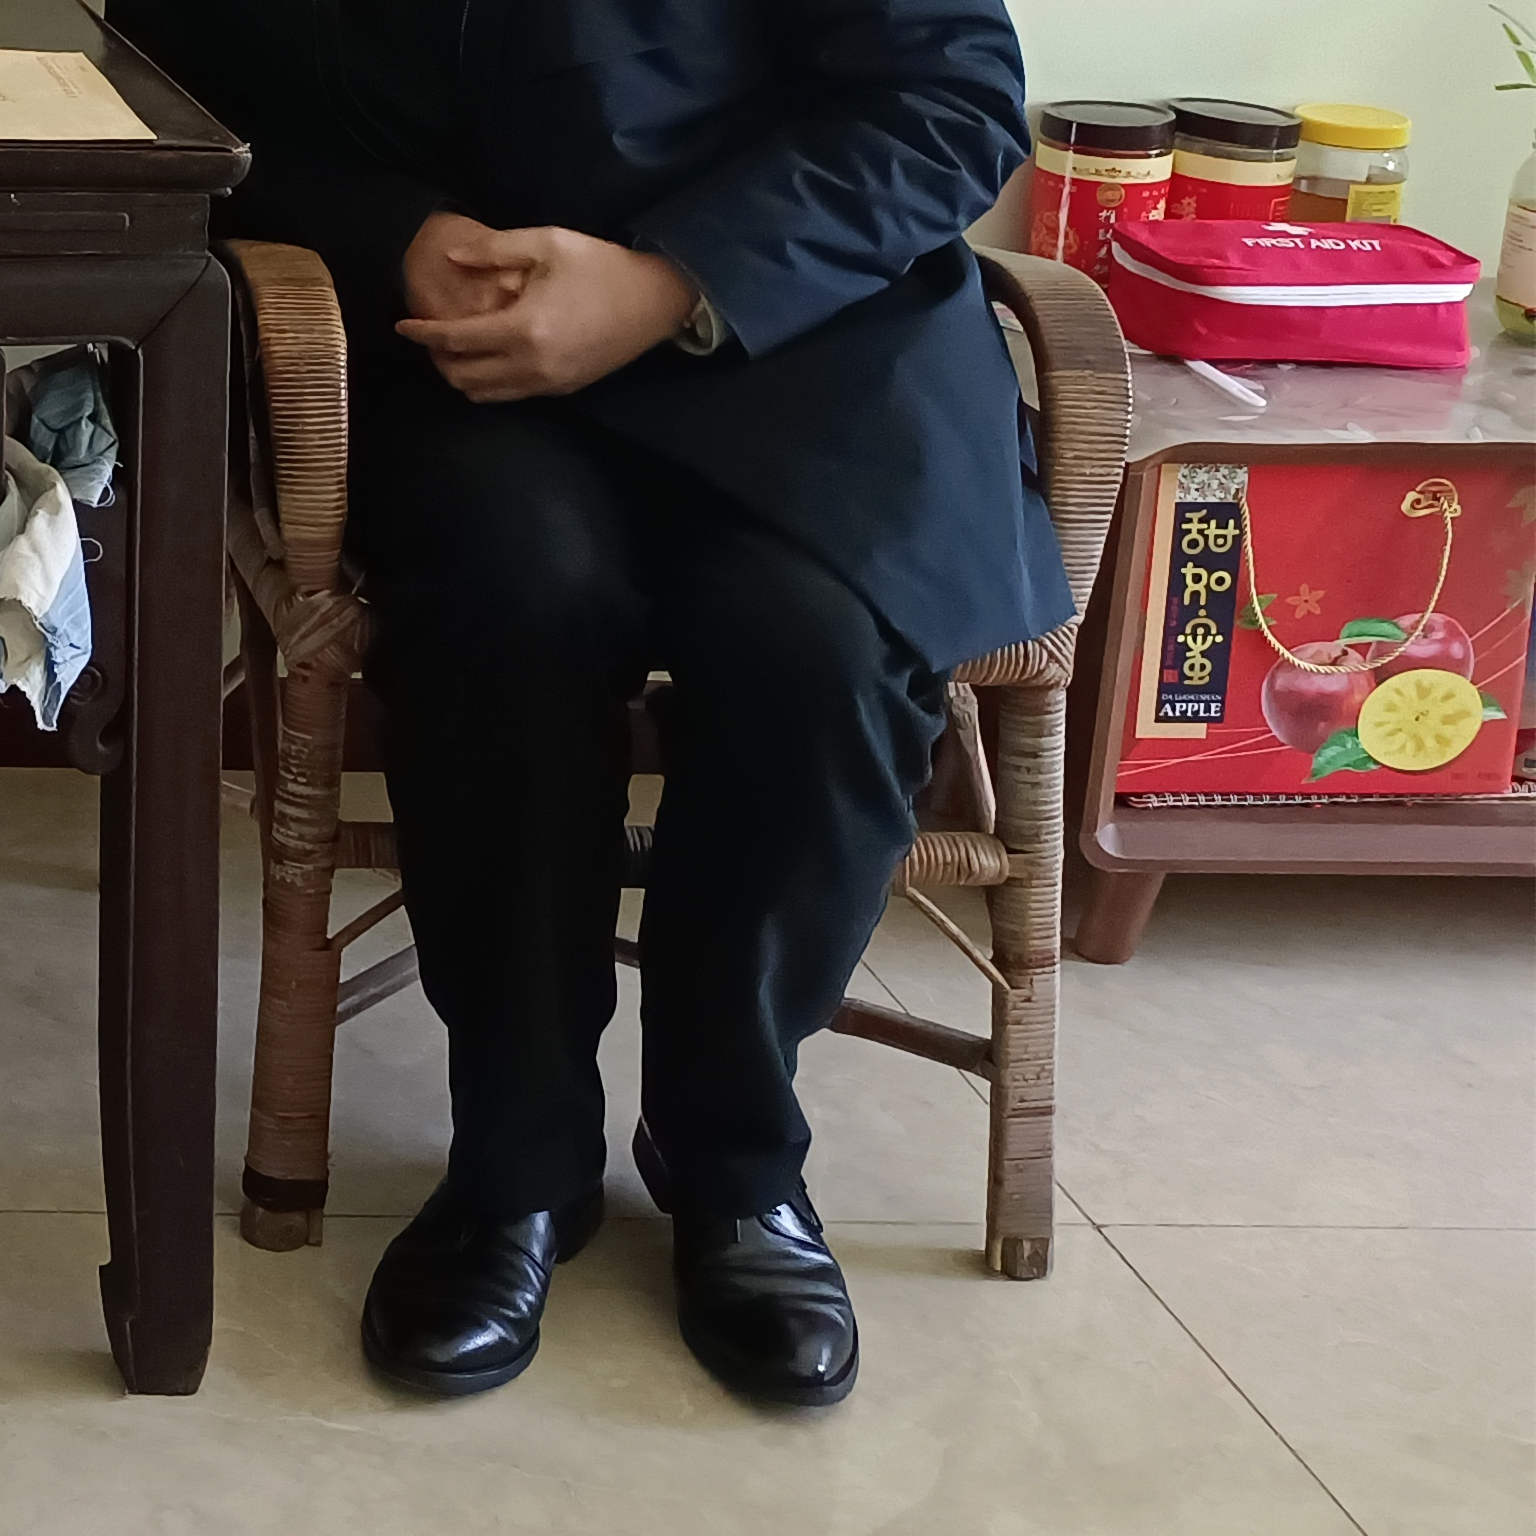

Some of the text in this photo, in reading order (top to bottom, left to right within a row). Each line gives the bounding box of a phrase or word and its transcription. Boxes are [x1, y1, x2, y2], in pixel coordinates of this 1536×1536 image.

[1241, 238, 1382, 251] FIRST AID KIT
[1177, 509, 1240, 686] 甜如蜜
[1158, 702, 1222, 717] APPLE
